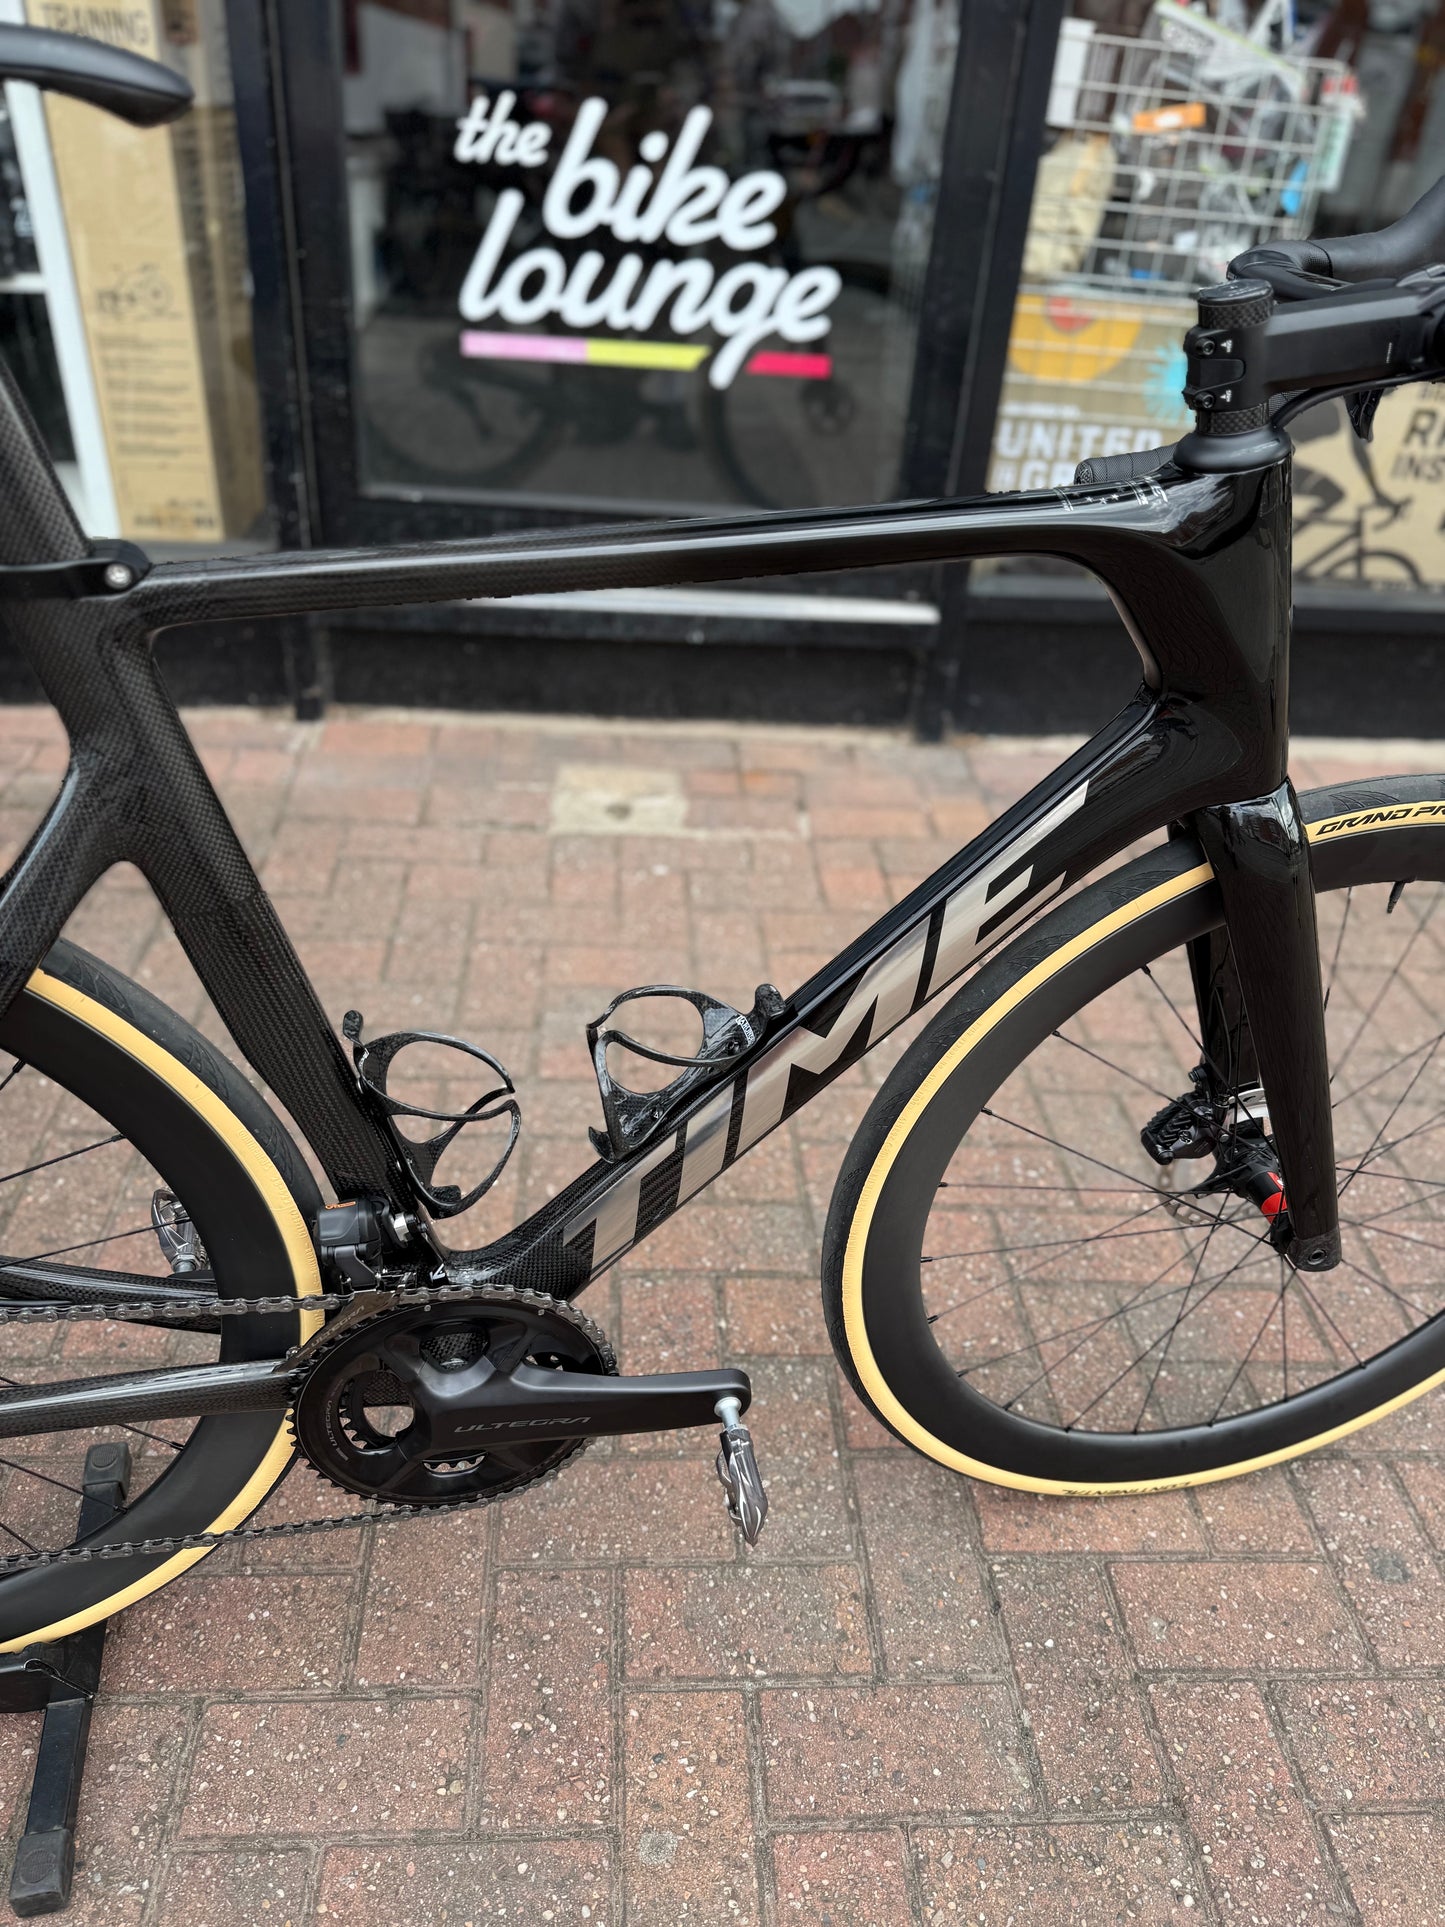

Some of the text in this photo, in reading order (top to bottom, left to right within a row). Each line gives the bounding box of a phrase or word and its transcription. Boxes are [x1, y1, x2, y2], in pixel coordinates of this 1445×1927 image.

[453, 89, 788, 251] the bike
[457, 187, 843, 391] lounge
[994, 419, 1164, 461] UNITED
[1316, 808, 1413, 836] GRAND
[563, 779, 1090, 1281] TIME
[454, 1416, 592, 1433] ULTEGRA
